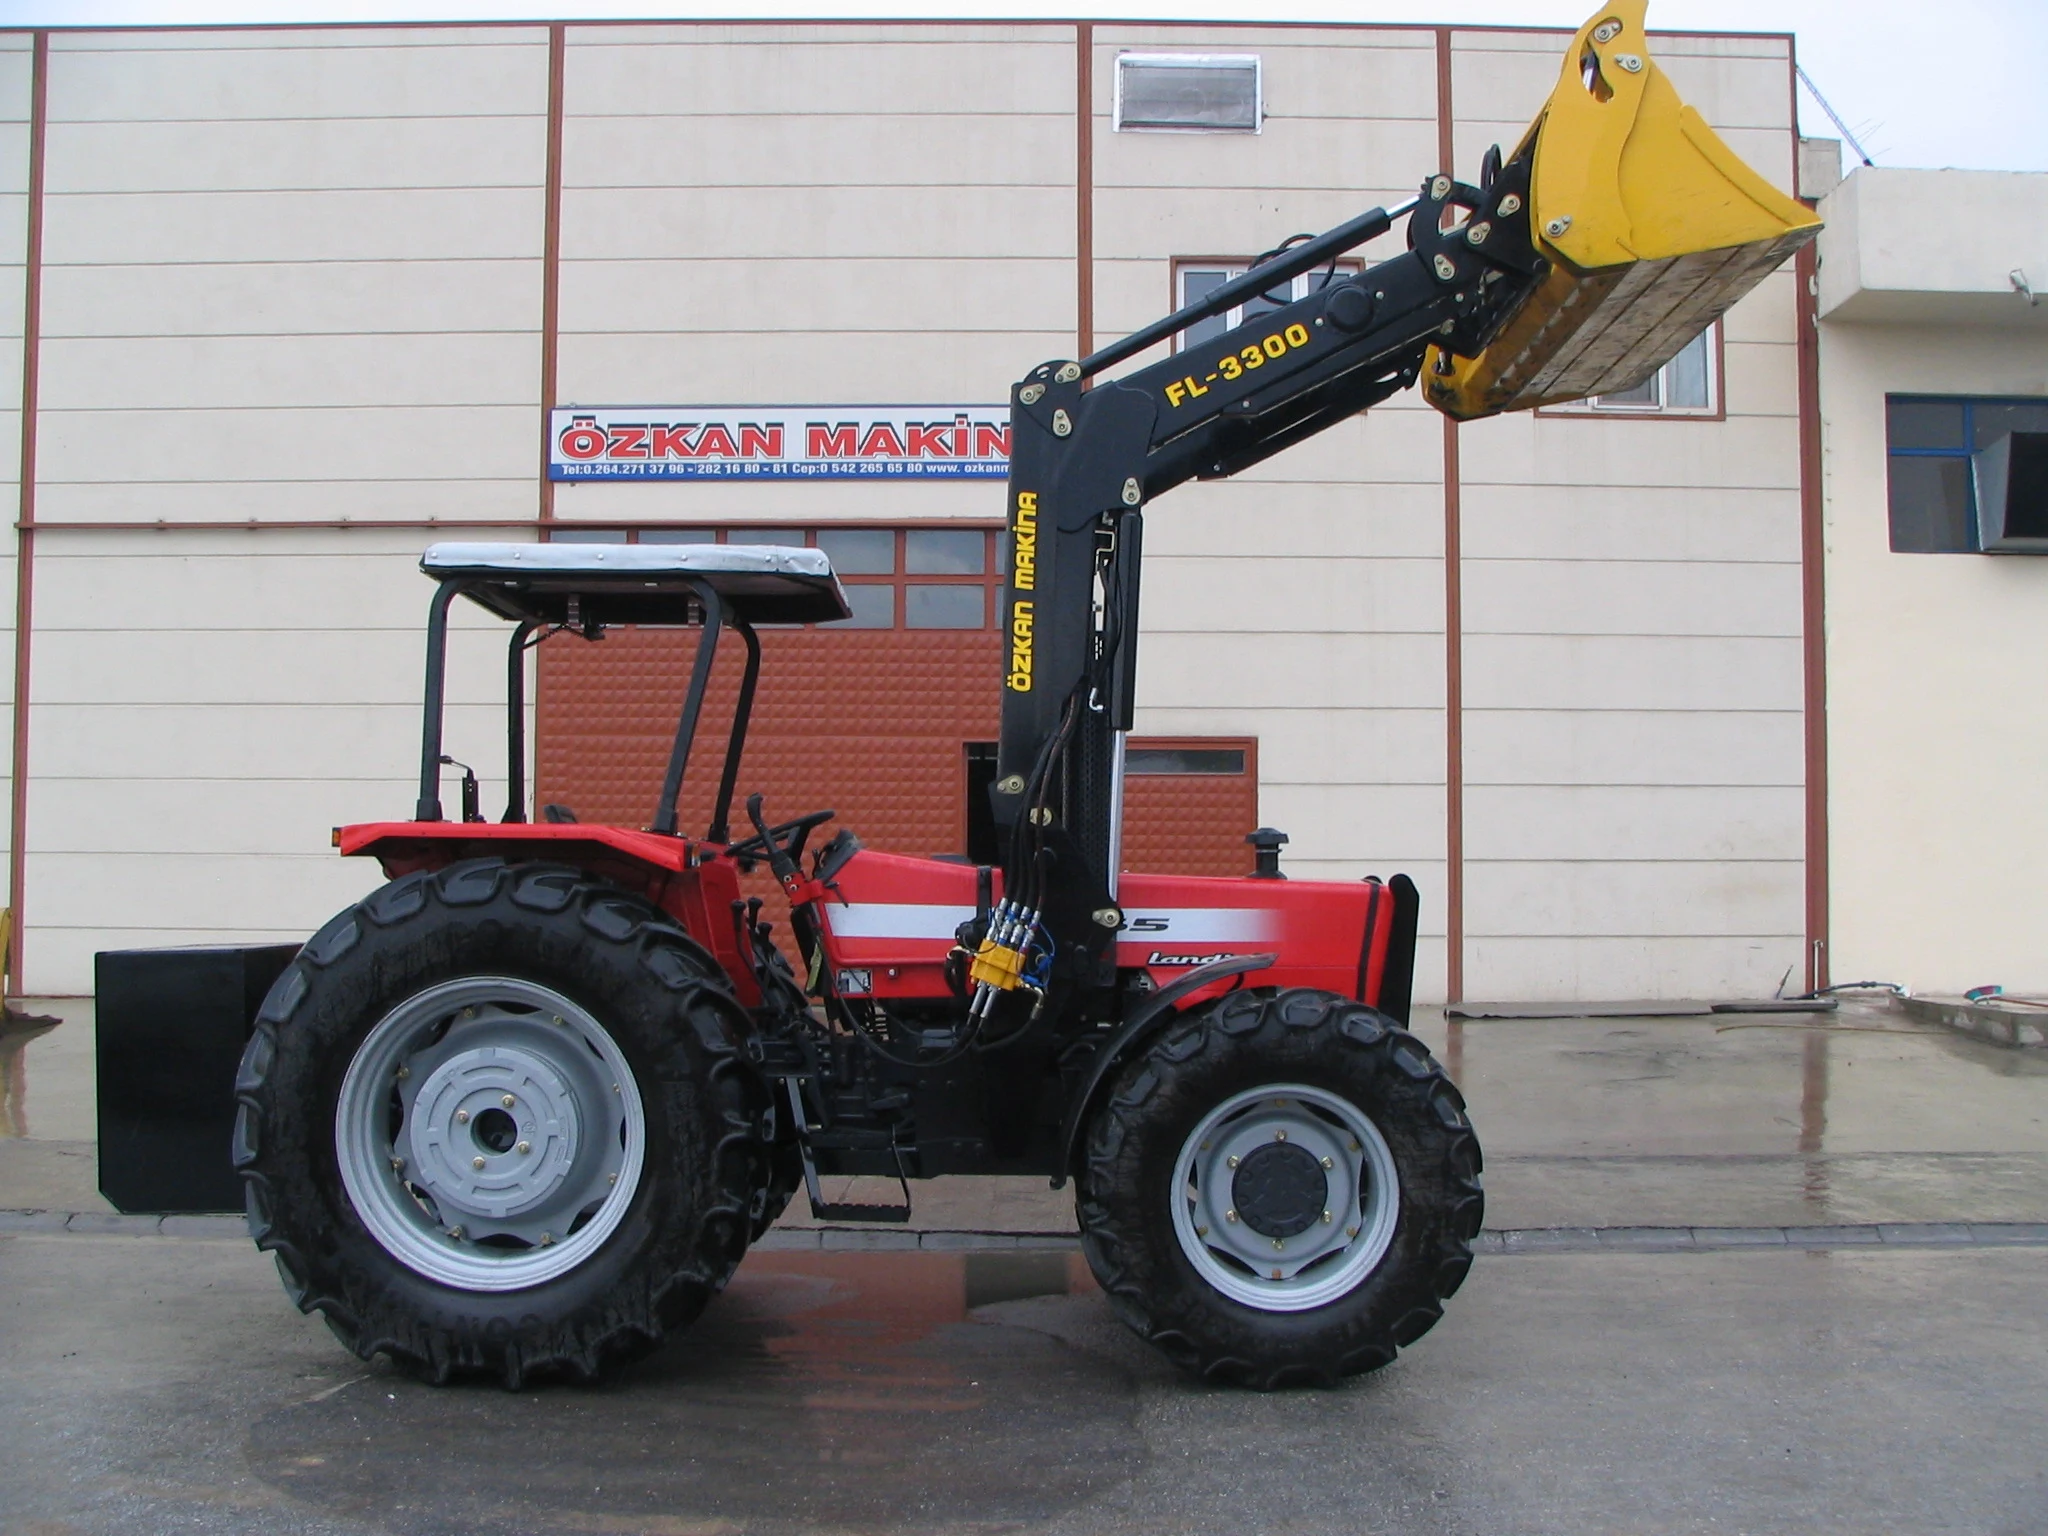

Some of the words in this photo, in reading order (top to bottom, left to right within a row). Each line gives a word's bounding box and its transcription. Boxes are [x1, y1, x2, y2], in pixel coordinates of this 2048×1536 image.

[1163, 323, 1310, 408] FL-3300
[559, 415, 785, 460] ÖZKAN
[649, 464, 665, 474] 37
[831, 463, 856, 474] 542
[1007, 601, 1034, 692] ÖZKAN
